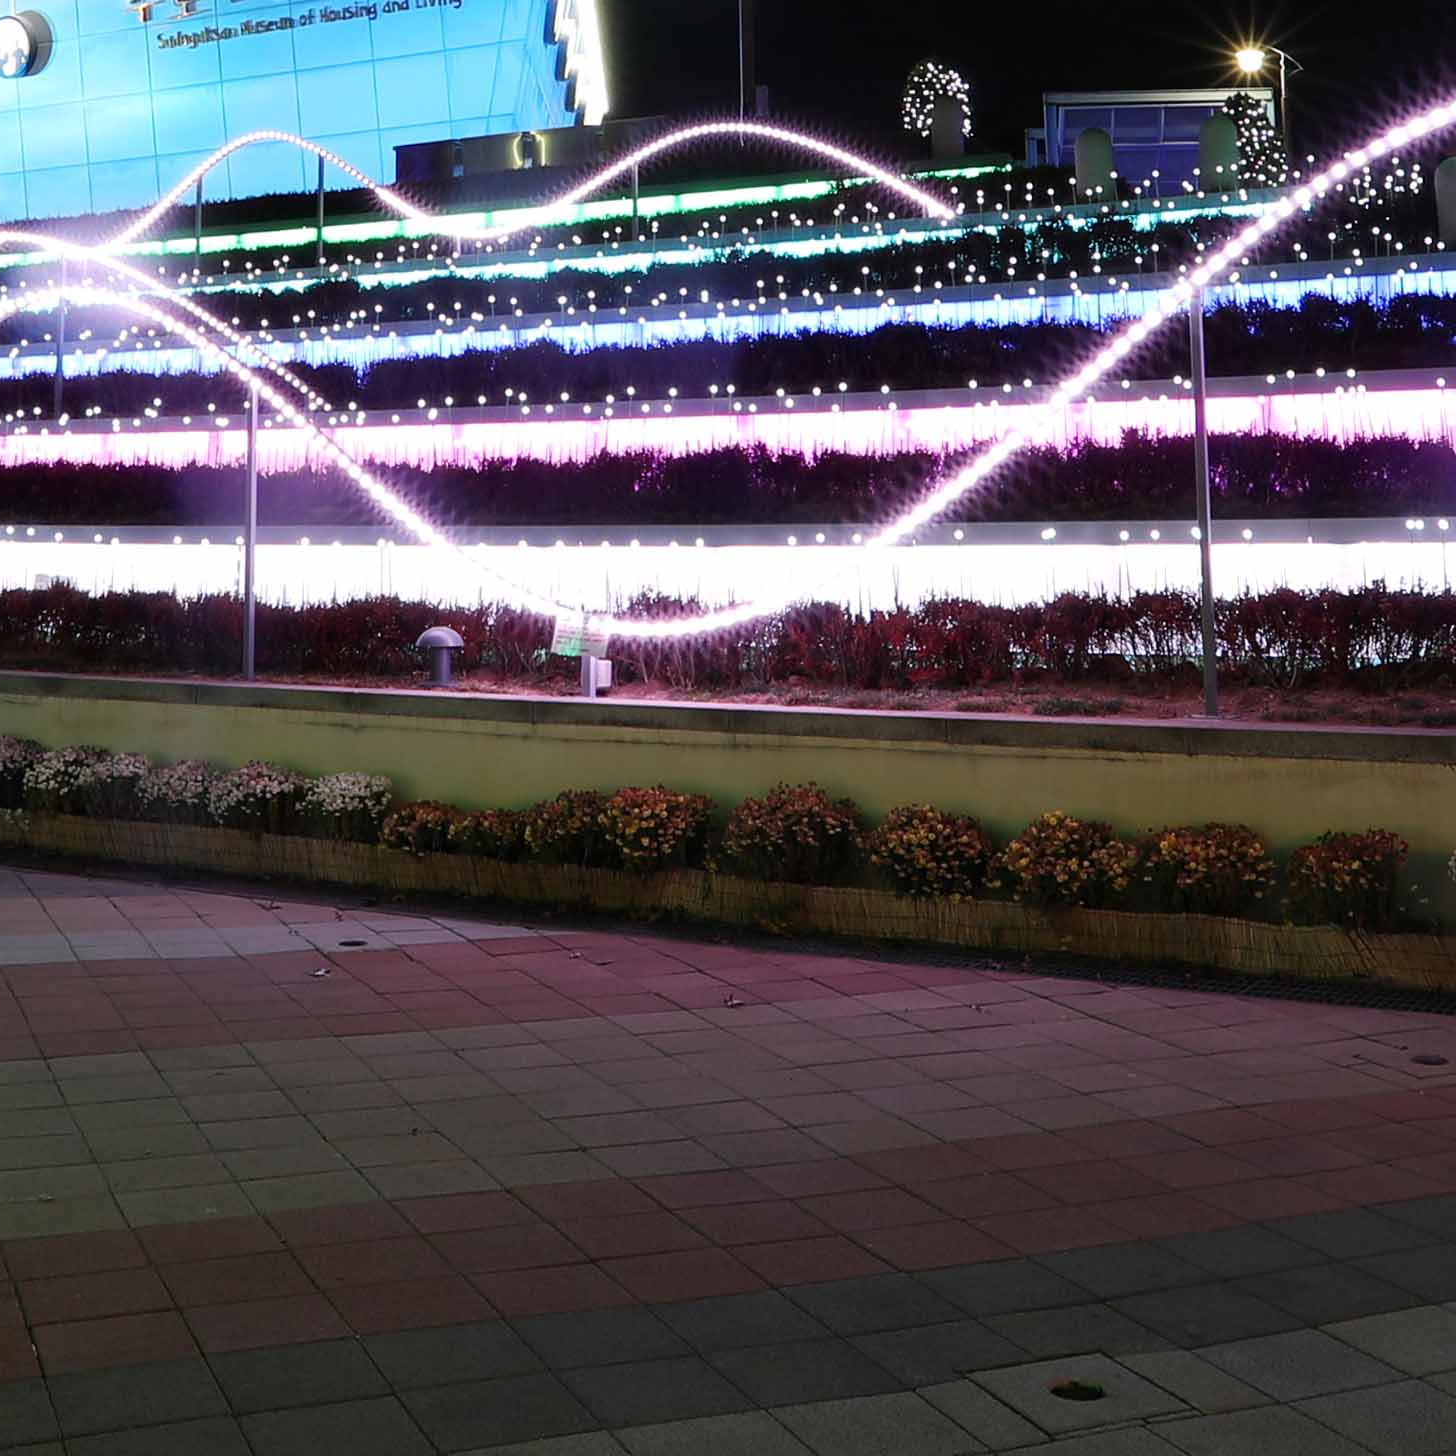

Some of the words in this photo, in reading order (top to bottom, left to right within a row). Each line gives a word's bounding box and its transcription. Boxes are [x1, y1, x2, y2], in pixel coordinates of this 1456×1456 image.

[240, 15, 295, 36] Museum
[299, 10, 317, 27] of
[319, 1, 378, 23] Housing
